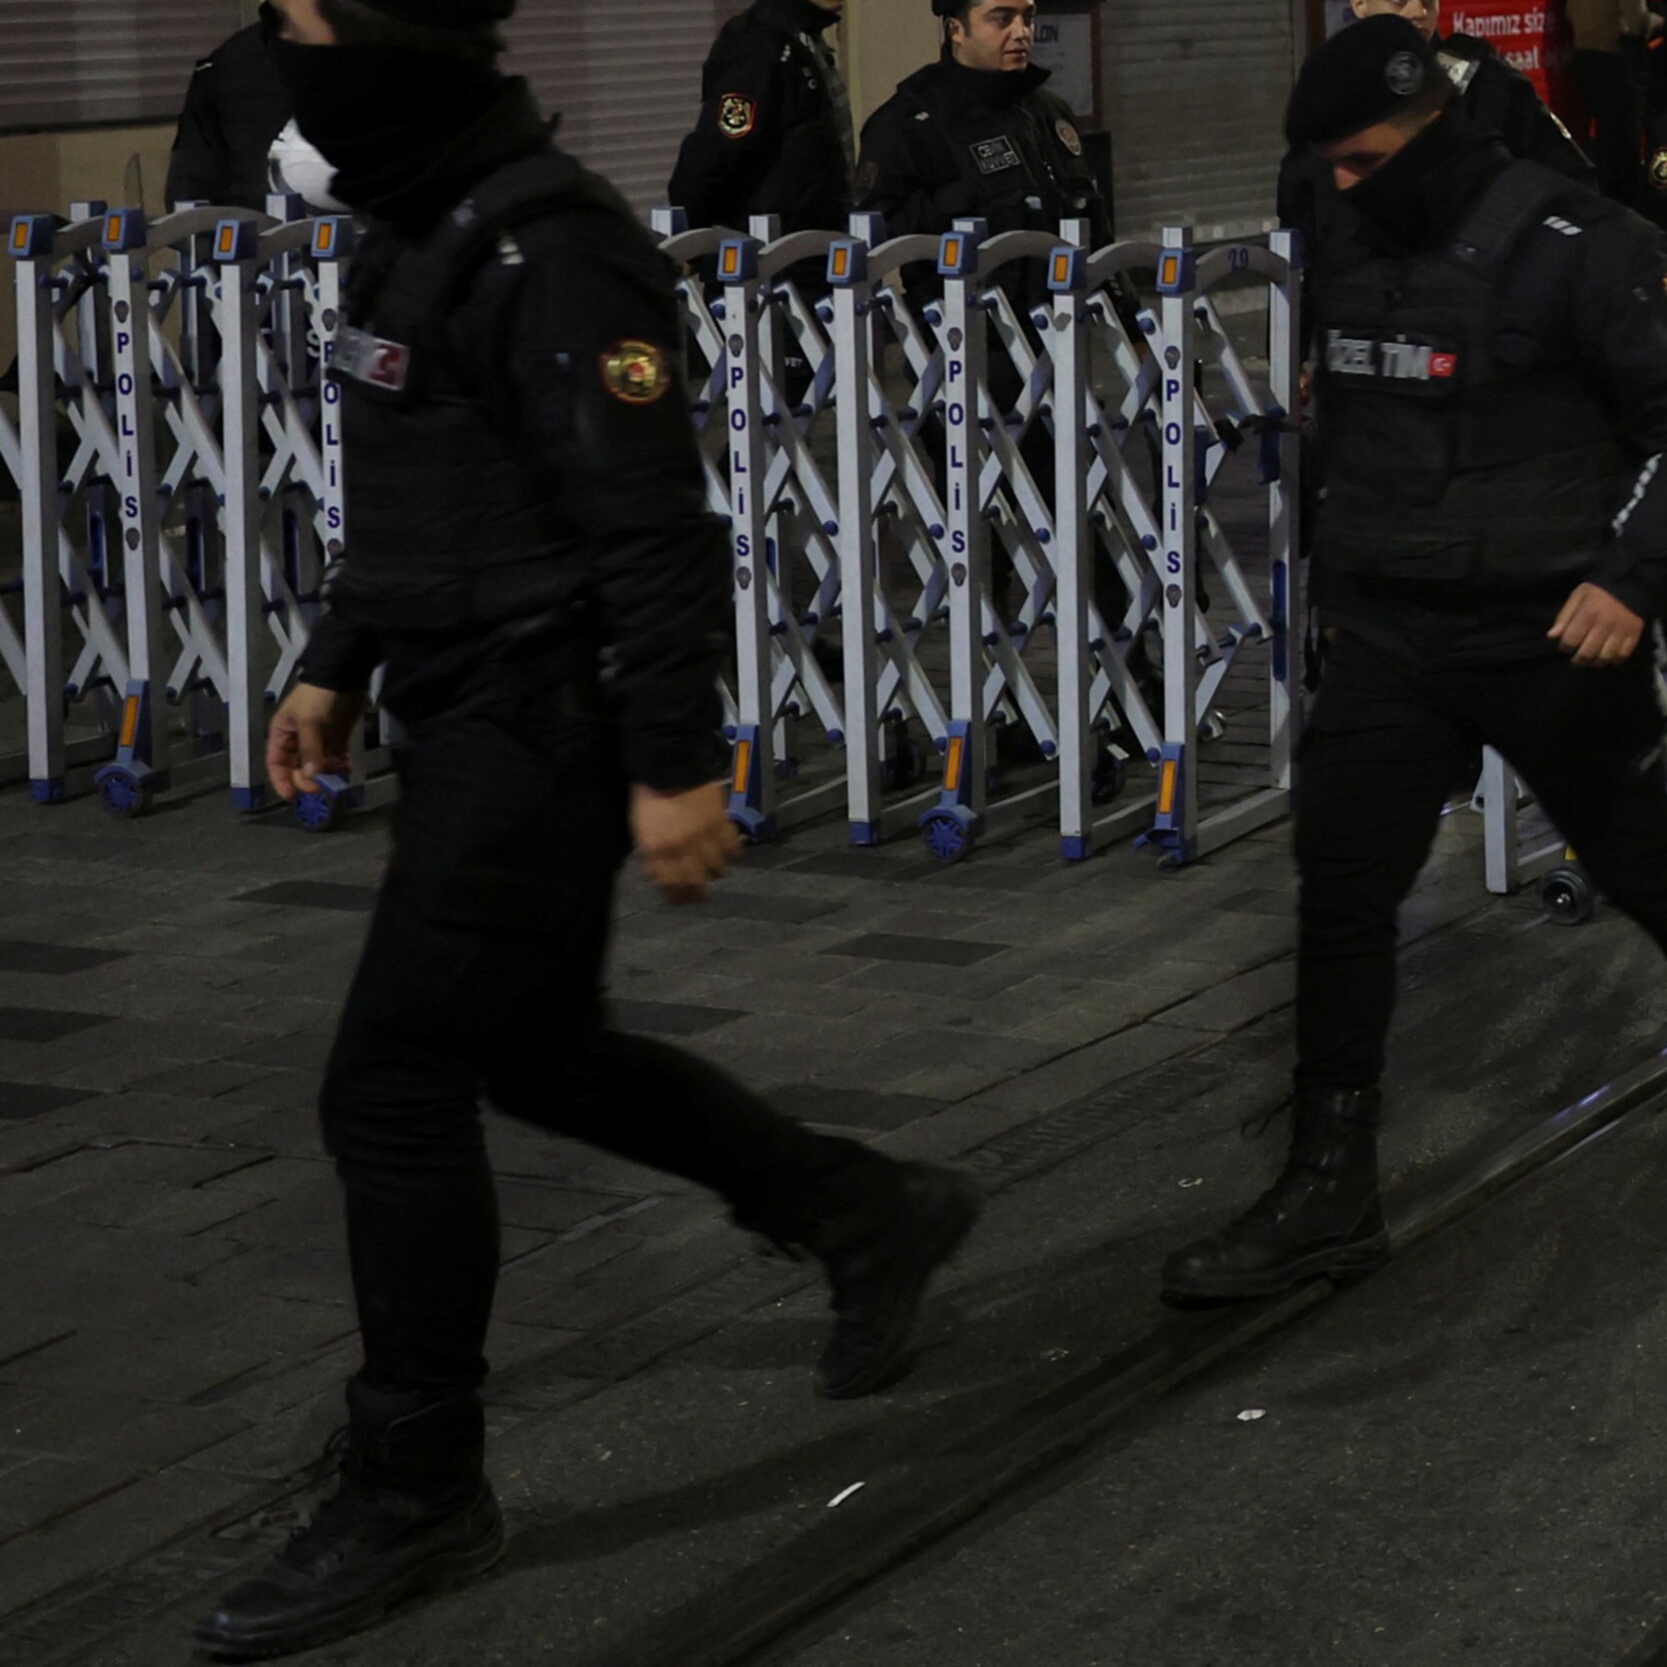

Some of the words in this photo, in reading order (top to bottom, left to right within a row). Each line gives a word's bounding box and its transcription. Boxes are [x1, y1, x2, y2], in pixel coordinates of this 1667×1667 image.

[1227, 247, 1249, 271] 29
[117, 332, 140, 520] POLİS
[1381, 334, 1433, 381] TİM
[729, 365, 751, 559] POLİS
[946, 359, 967, 554] POLİS
[1165, 377, 1183, 576] POLİS
